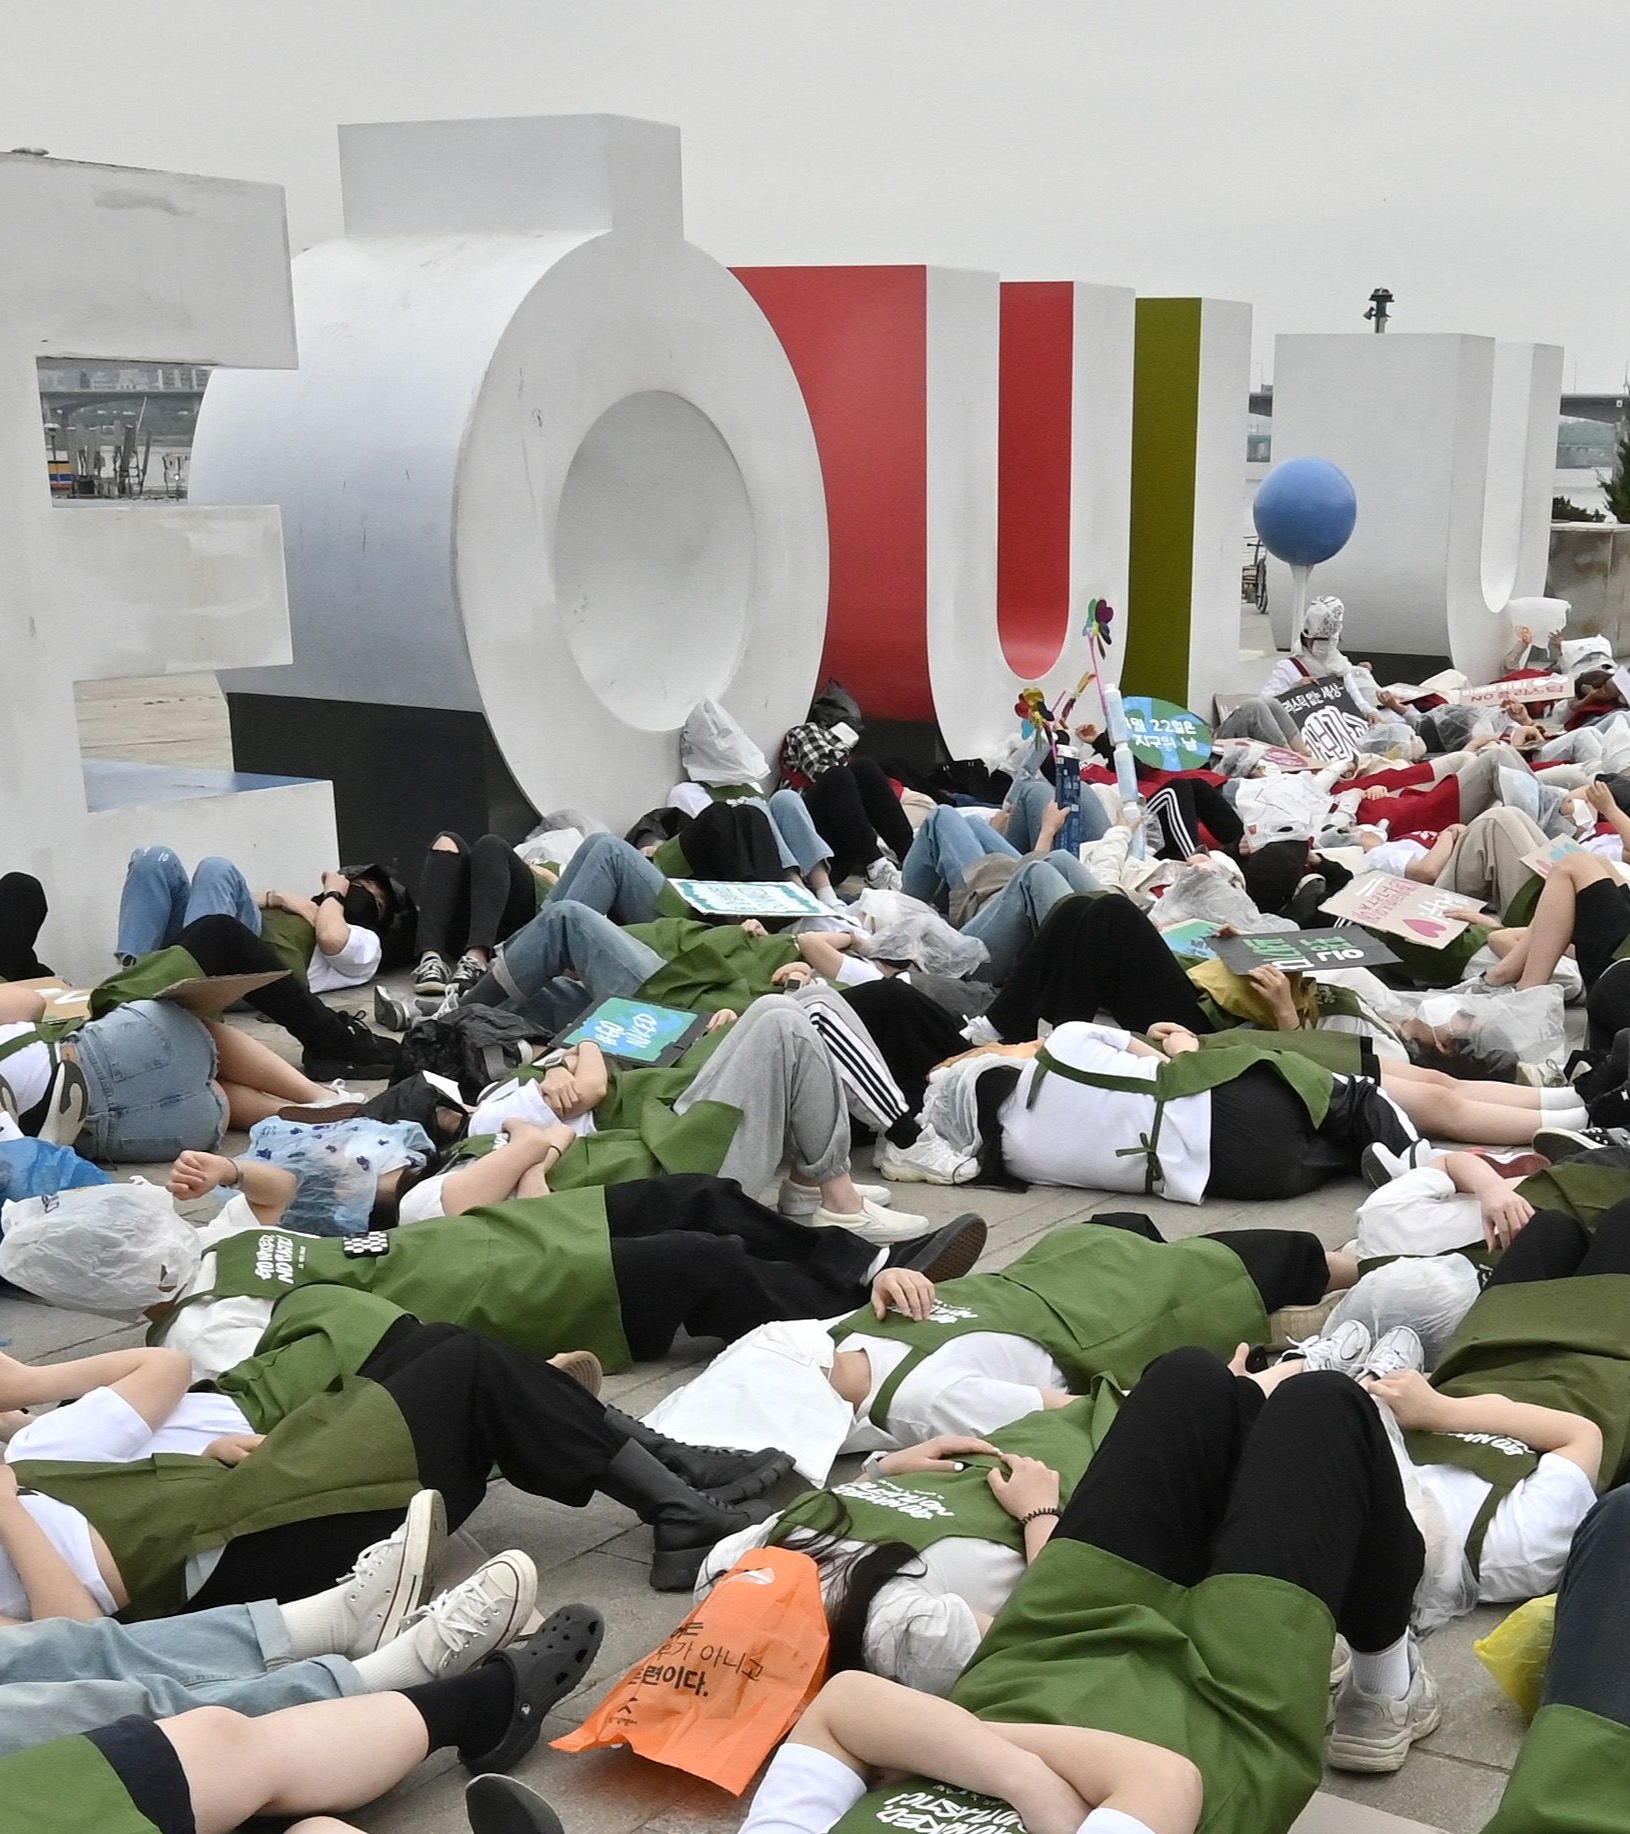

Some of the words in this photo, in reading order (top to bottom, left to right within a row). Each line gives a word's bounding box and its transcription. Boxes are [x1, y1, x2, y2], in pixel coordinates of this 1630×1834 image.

[1150, 718, 1197, 734] 22일은
[1132, 734, 1177, 749] 지구의
[1180, 736, 1198, 751] 날
[699, 1644, 765, 1682] 아니고
